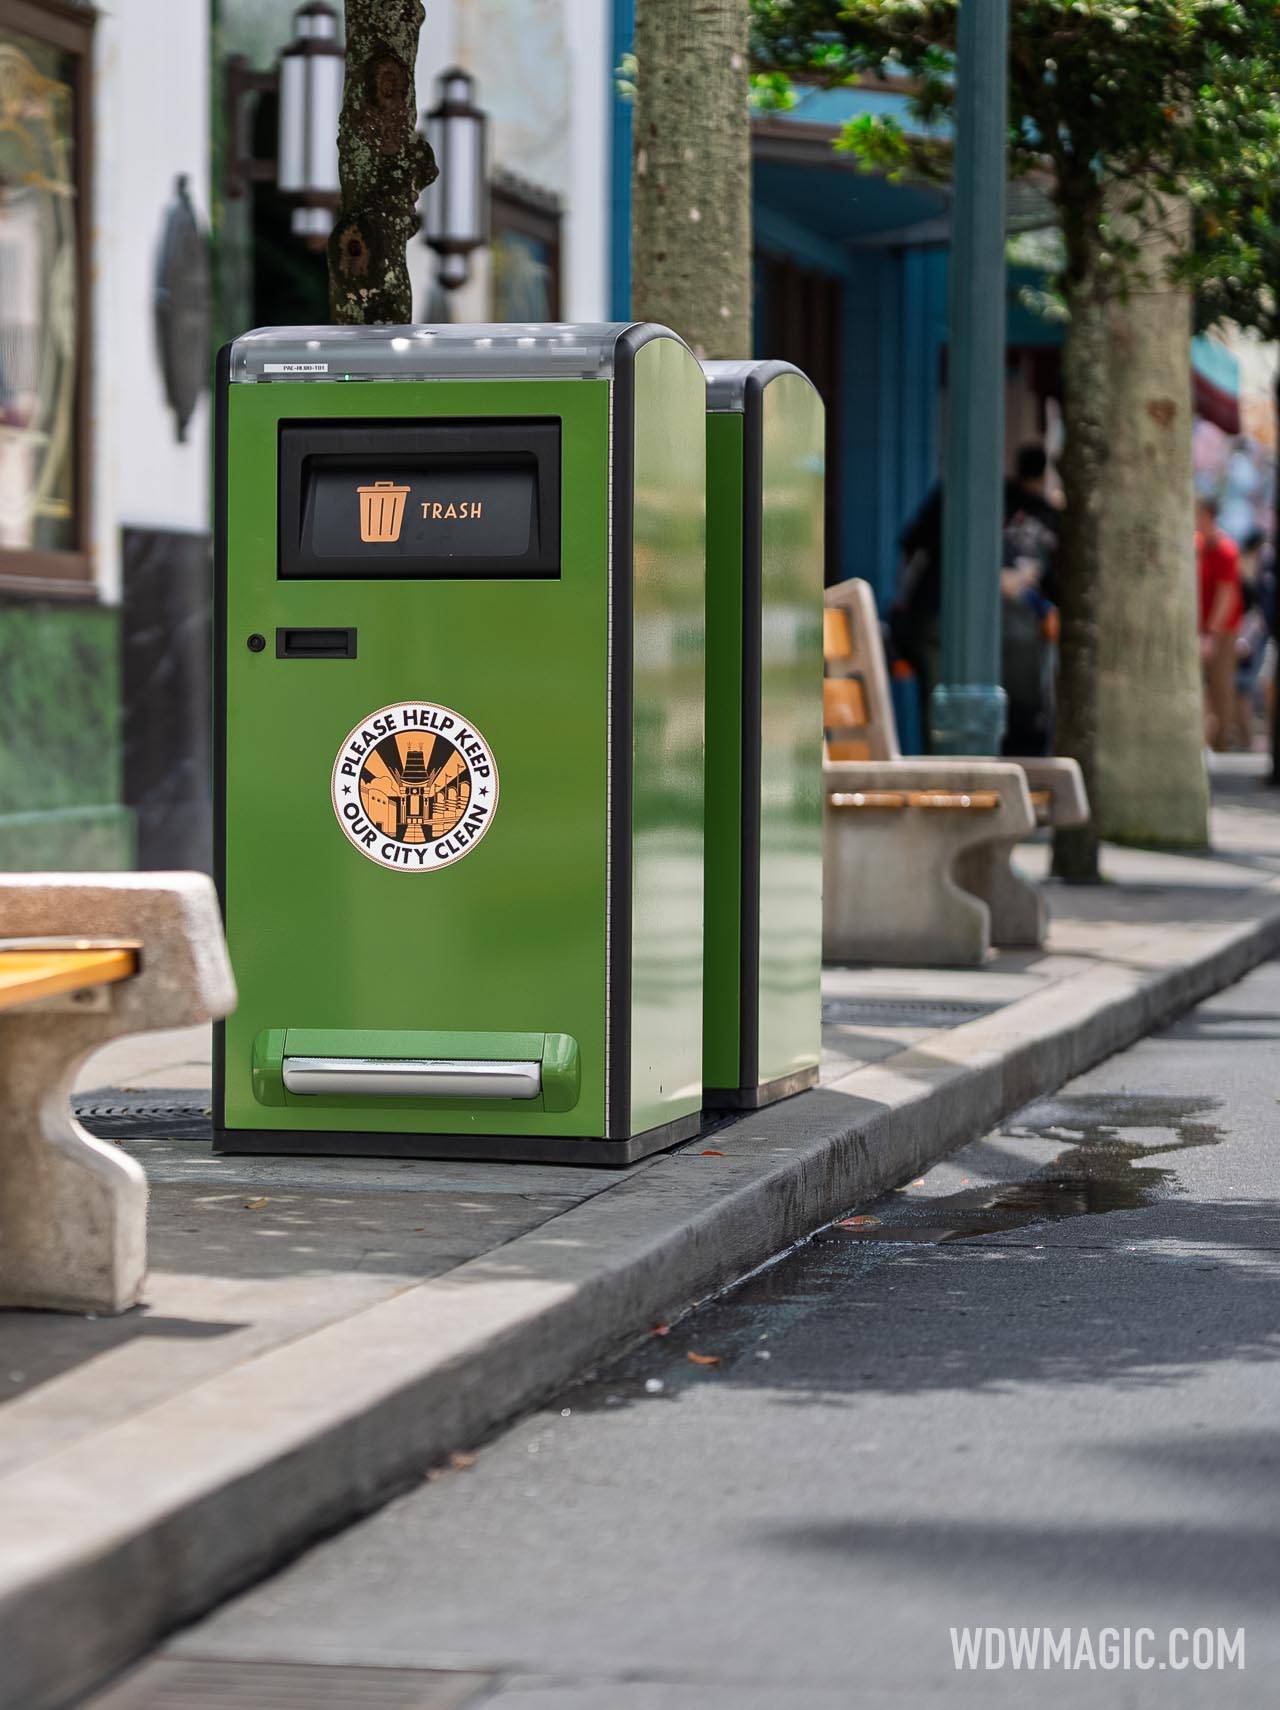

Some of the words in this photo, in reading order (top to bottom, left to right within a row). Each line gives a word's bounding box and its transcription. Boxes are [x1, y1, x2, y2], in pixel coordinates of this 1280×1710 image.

[421, 502, 482, 519] TRASH
[341, 714, 397, 777] PLEASE
[403, 709, 455, 731] HELP
[454, 728, 490, 778] KEEP
[343, 802, 378, 849] OUR
[381, 843, 429, 864] CITY
[435, 804, 488, 859] CLEAN
